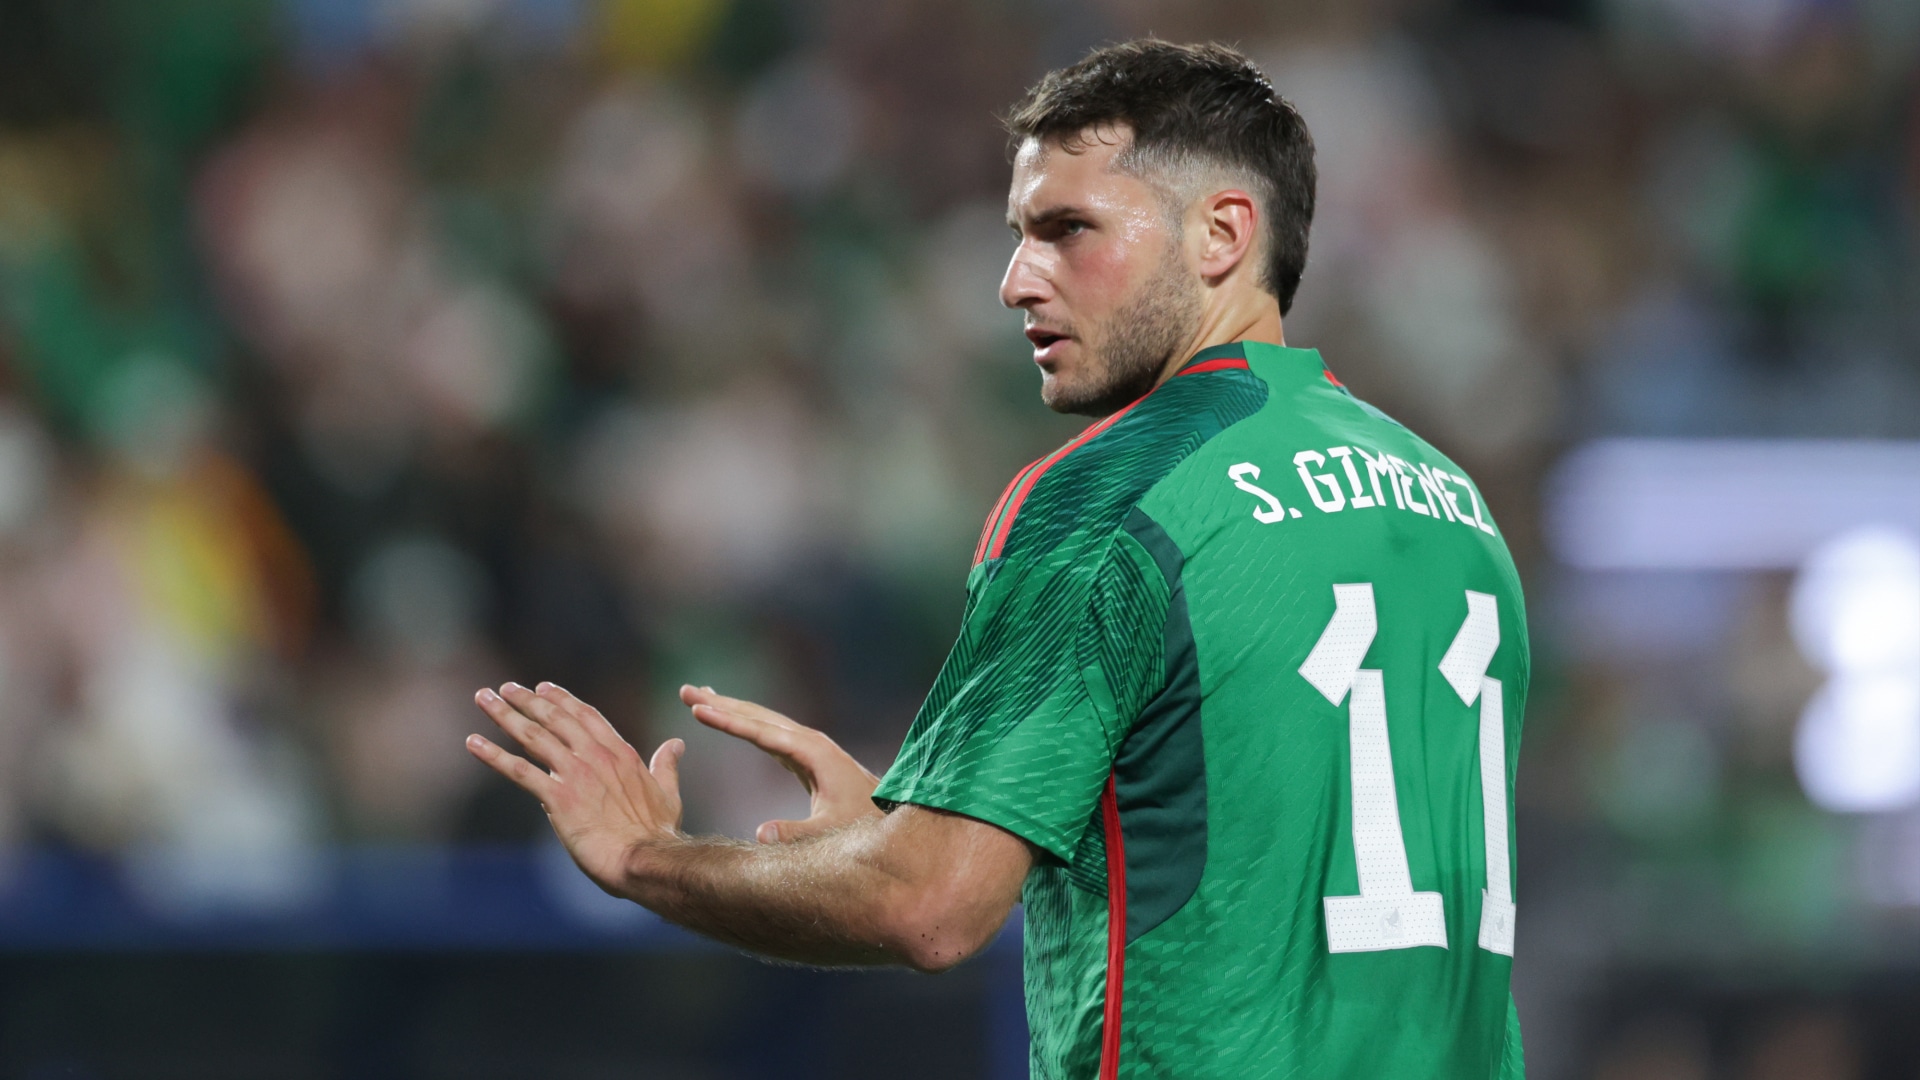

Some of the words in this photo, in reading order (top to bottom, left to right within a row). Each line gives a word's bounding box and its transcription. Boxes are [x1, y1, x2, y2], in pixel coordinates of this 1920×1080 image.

[1228, 461, 1303, 524] S.
[1292, 446, 1496, 536] GIMENEZ
[1298, 582, 1516, 958] 11
